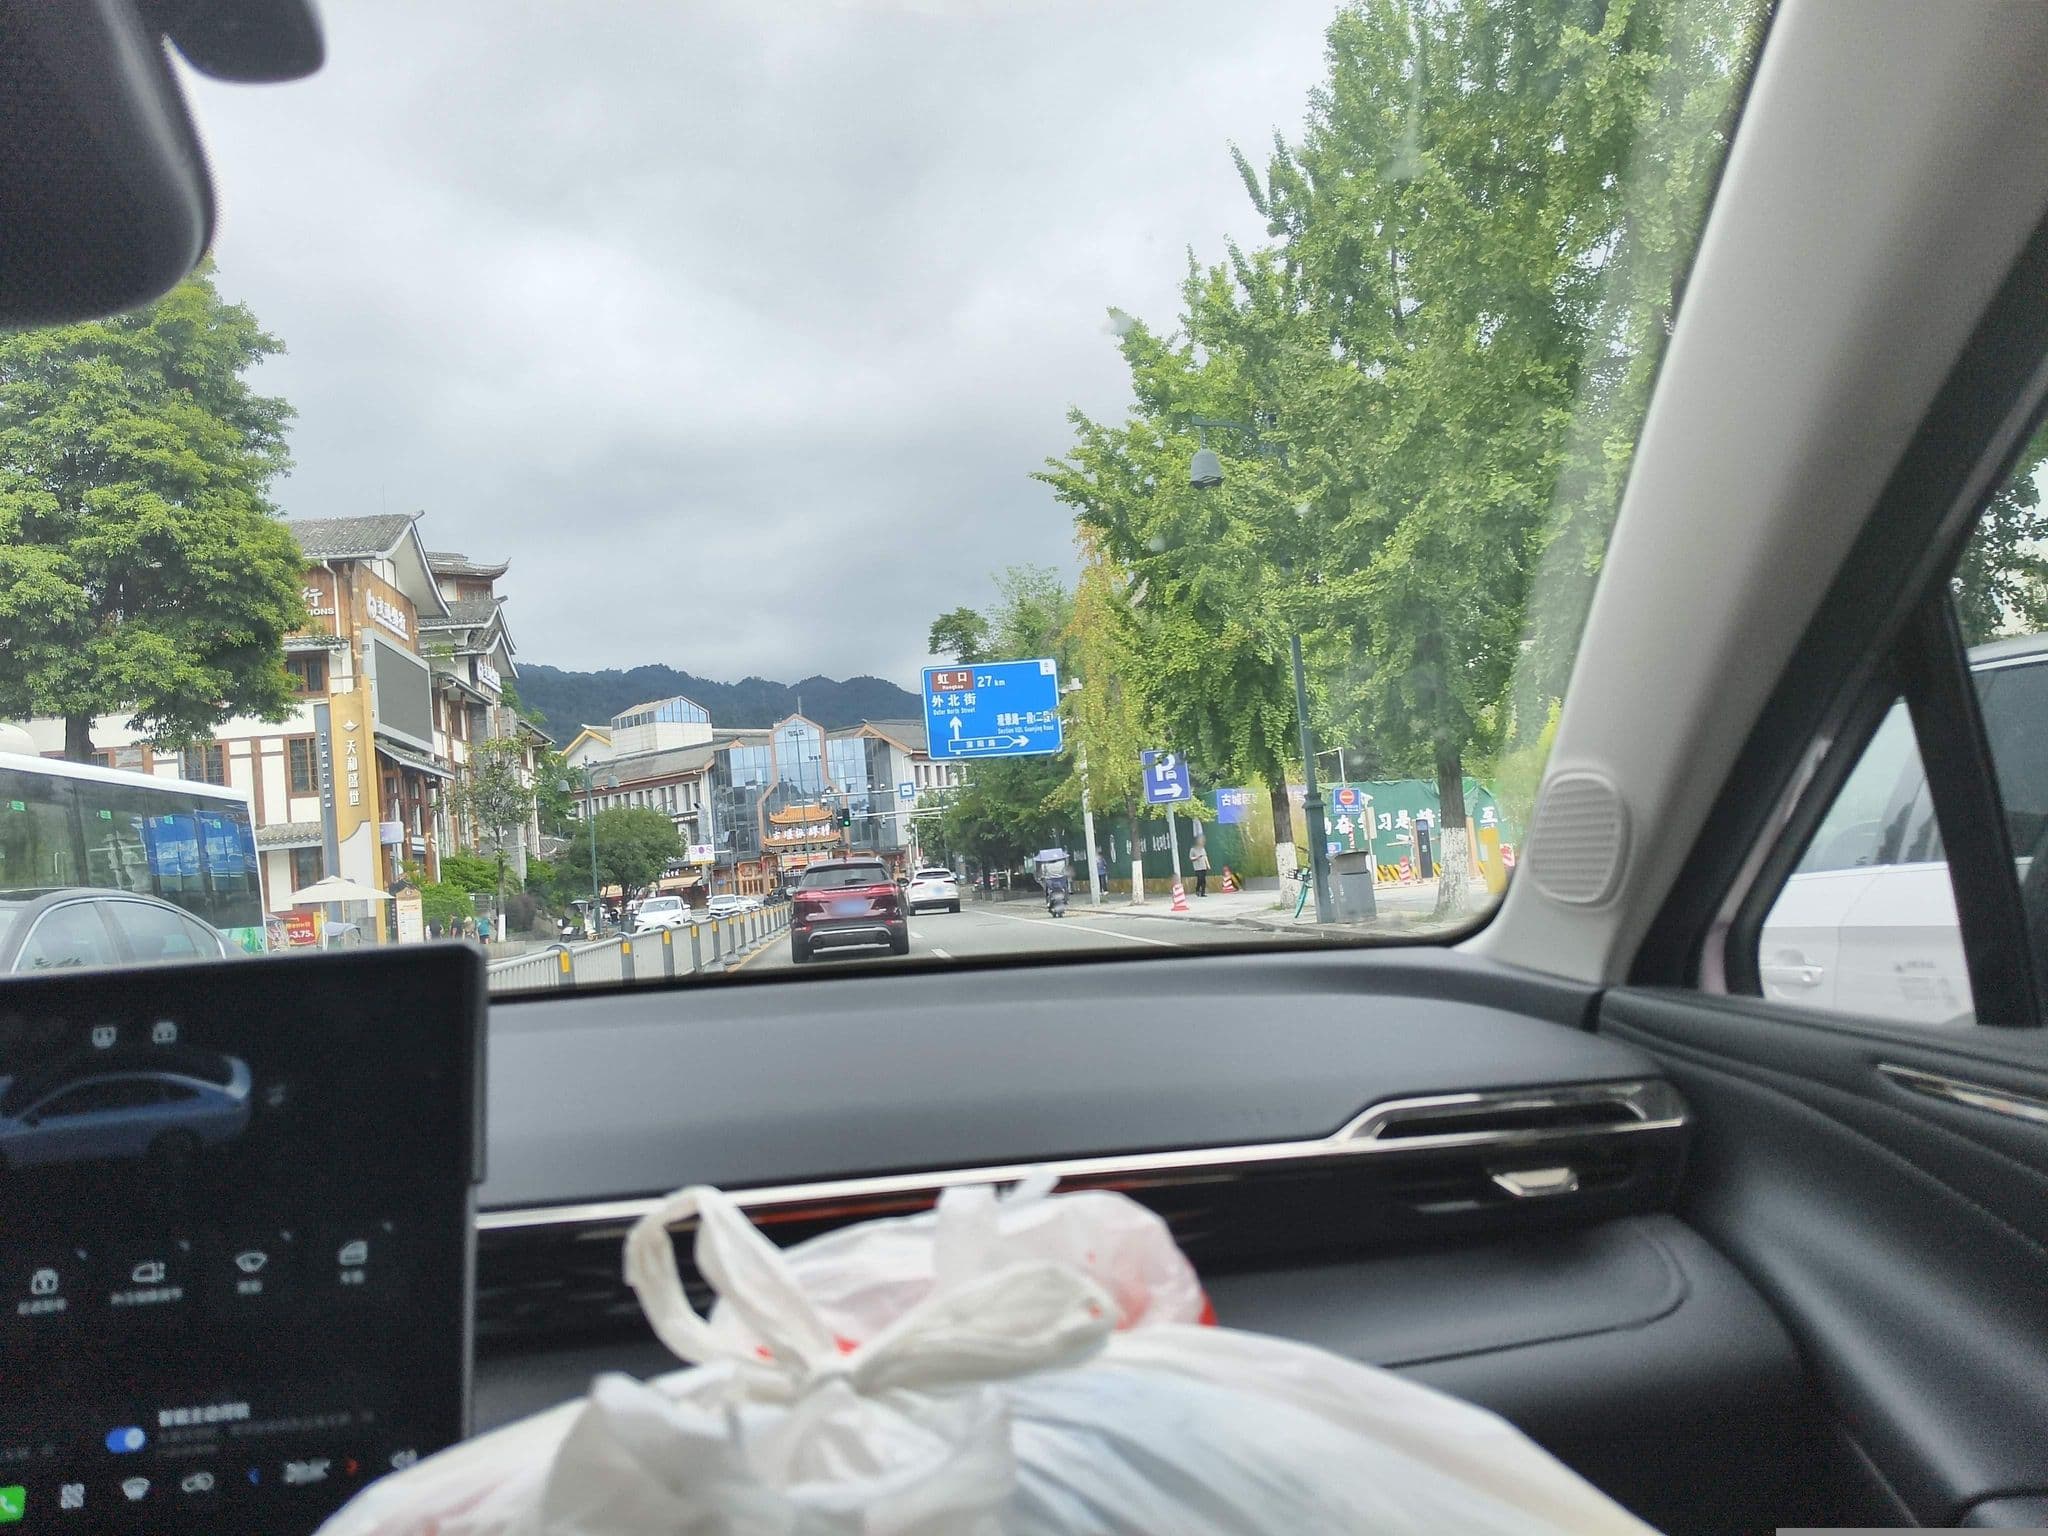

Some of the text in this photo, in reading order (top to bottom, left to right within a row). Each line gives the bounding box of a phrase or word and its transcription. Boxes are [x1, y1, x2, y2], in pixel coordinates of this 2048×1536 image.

[937, 672, 1006, 688] 虹口 27 km
[931, 692, 977, 708] 外北街
